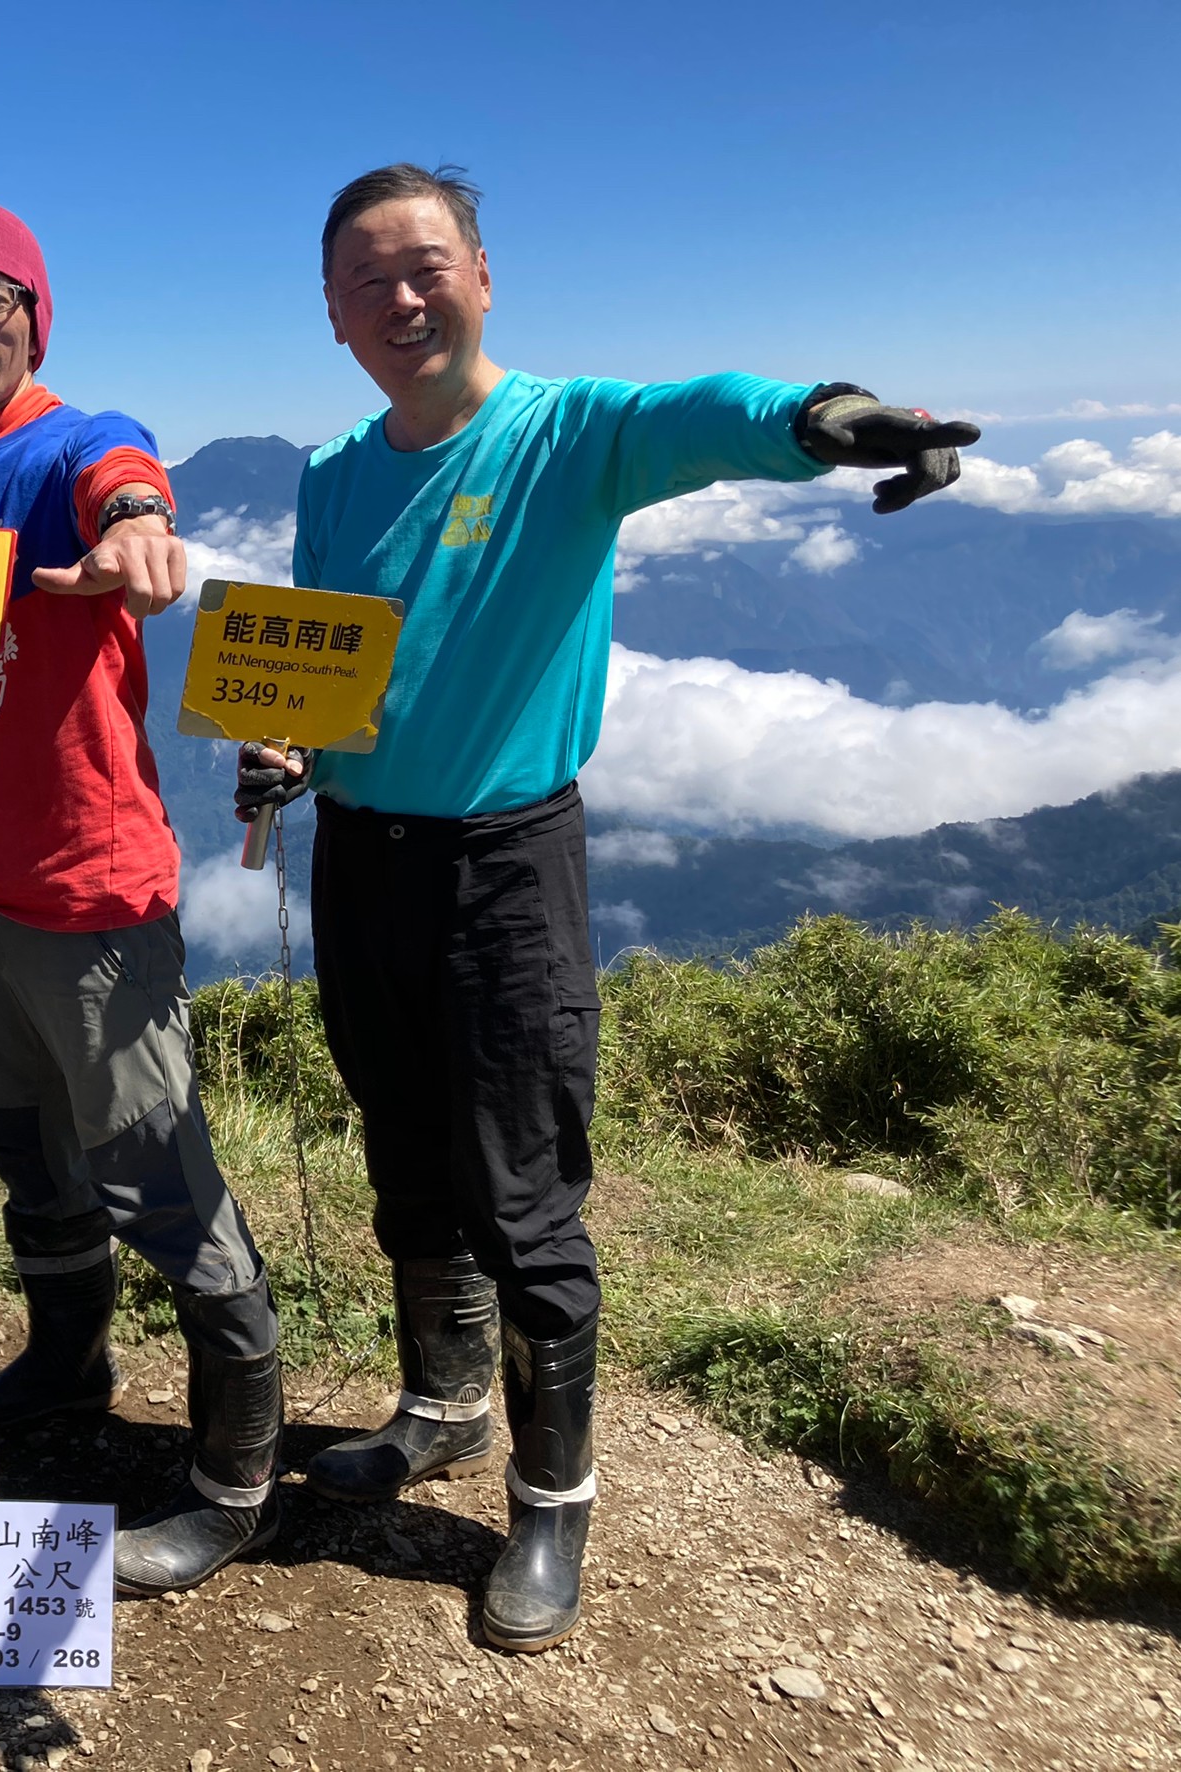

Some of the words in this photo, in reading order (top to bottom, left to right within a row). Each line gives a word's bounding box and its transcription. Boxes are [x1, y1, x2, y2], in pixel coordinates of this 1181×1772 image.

[222, 610, 364, 655] 能高南峰
[301, 662, 332, 676] South
[333, 666, 358, 679] Peak
[211, 677, 278, 707] 3349
[286, 694, 305, 710] M
[7, 1558, 81, 1590] 公尺
[3, 1596, 66, 1616] 1453
[73, 1597, 96, 1618] 號
[52, 1649, 100, 1668] 268
